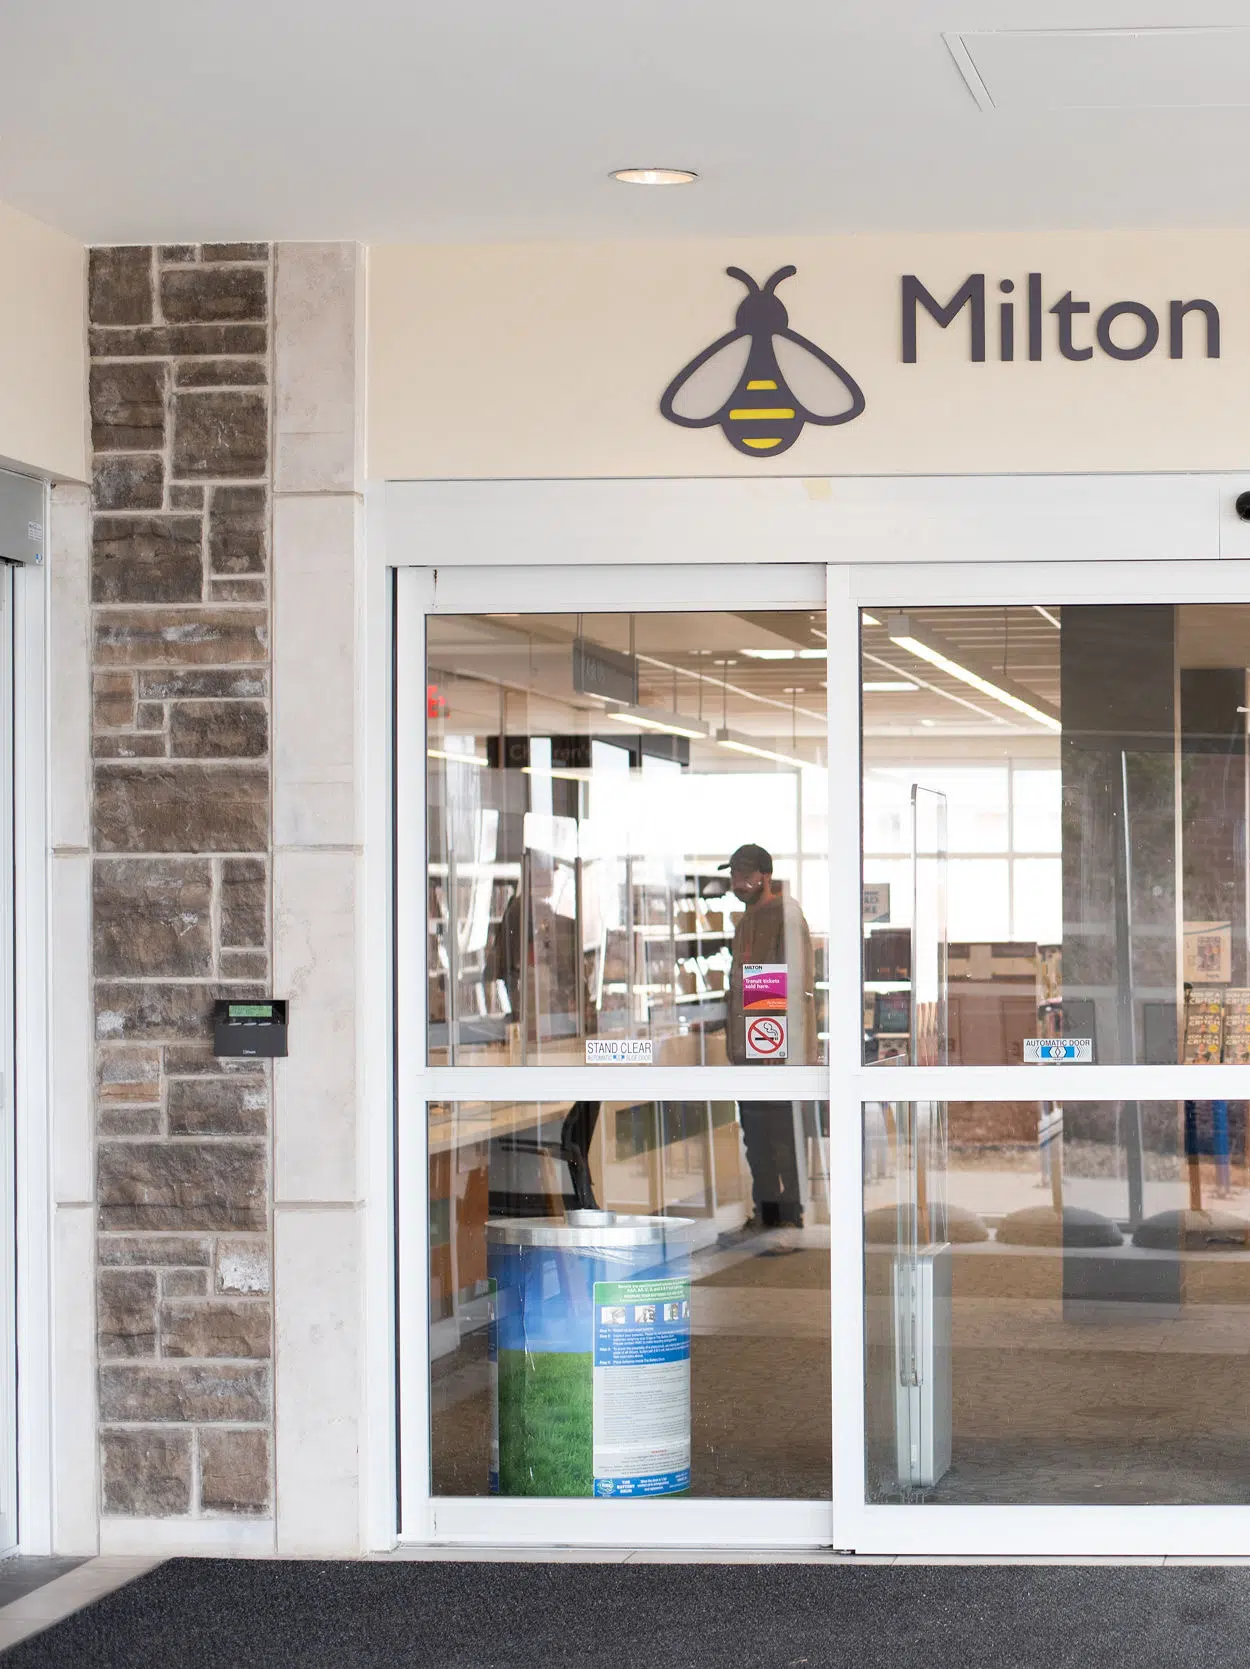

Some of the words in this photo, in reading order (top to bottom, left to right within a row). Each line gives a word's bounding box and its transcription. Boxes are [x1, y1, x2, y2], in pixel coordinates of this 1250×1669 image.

[901, 273, 1220, 363] Milton
[587, 1042, 618, 1054] STAND
[620, 1042, 652, 1054] CLEAR
[1026, 1039, 1067, 1047] AUTOMATIC
